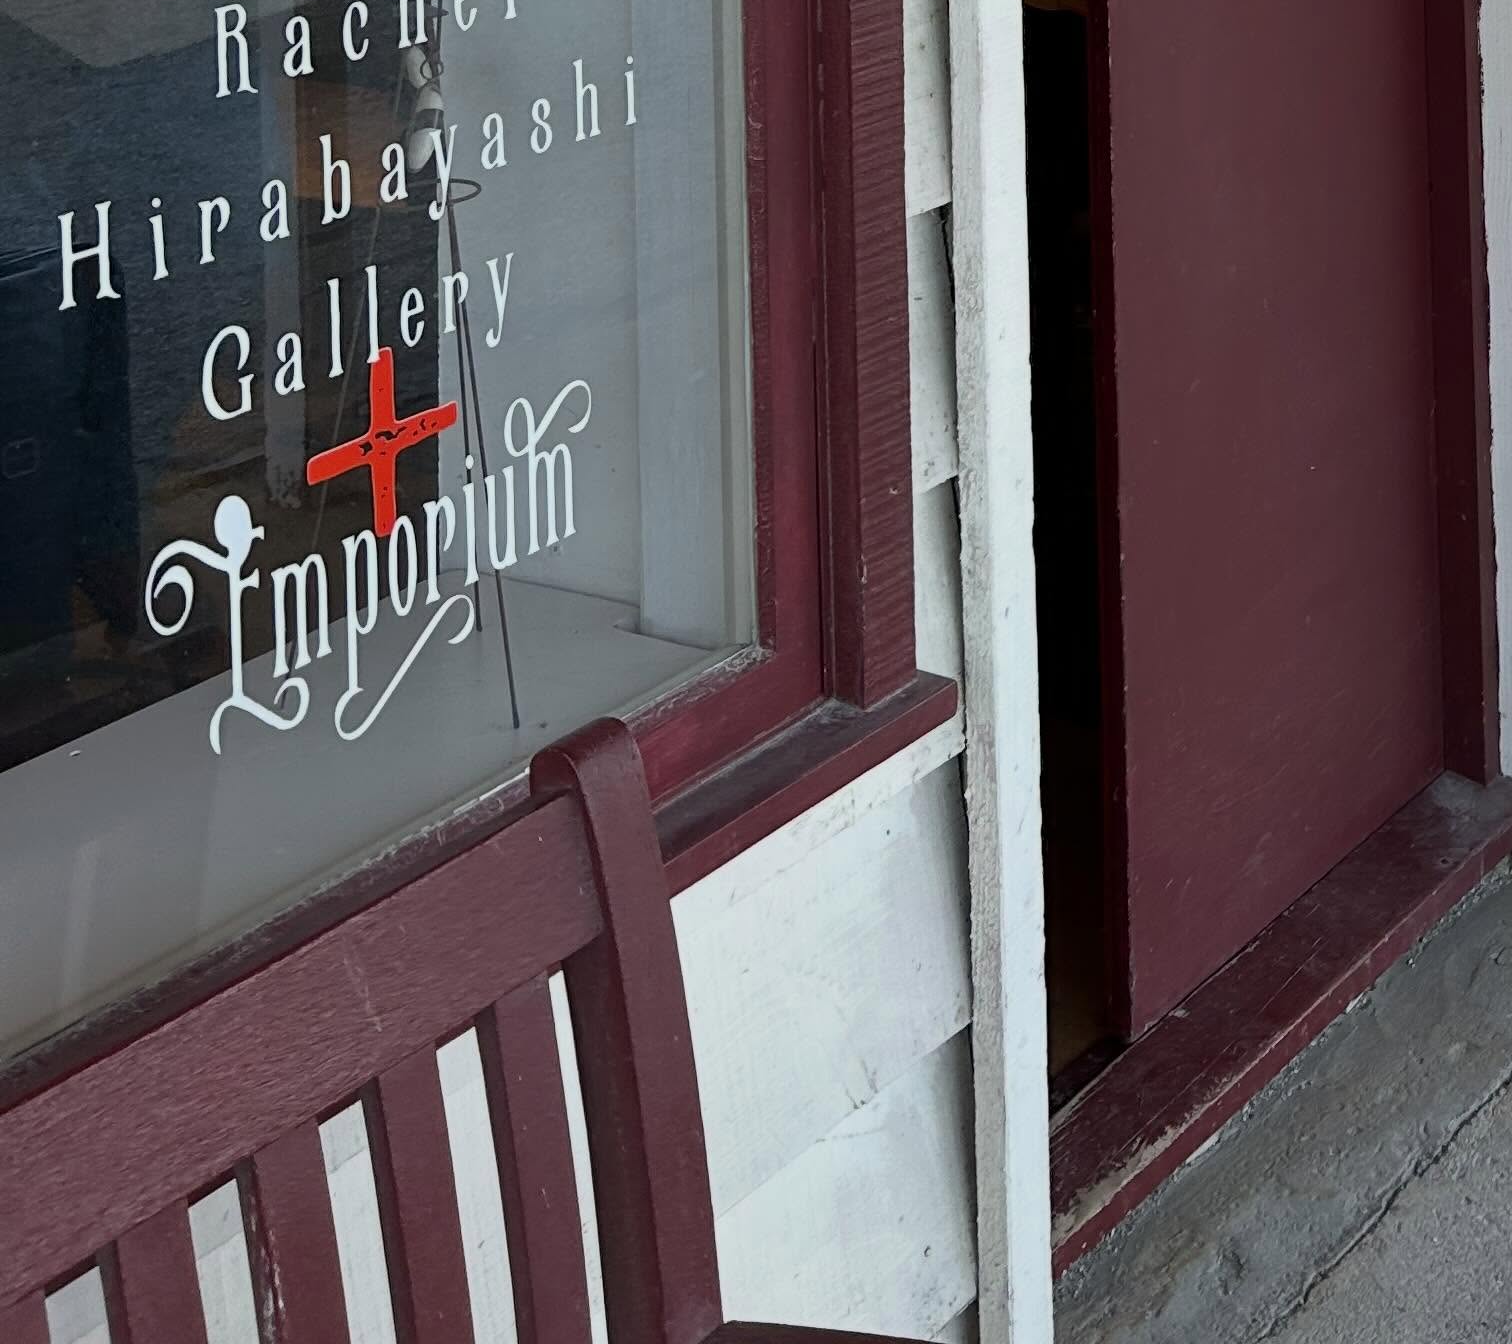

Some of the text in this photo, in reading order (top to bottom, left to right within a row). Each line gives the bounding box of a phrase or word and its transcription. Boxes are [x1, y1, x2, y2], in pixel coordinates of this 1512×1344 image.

[57, 55, 640, 312] Hirabayashi
[201, 252, 515, 422] Gallery
[144, 379, 593, 756] Emporium
